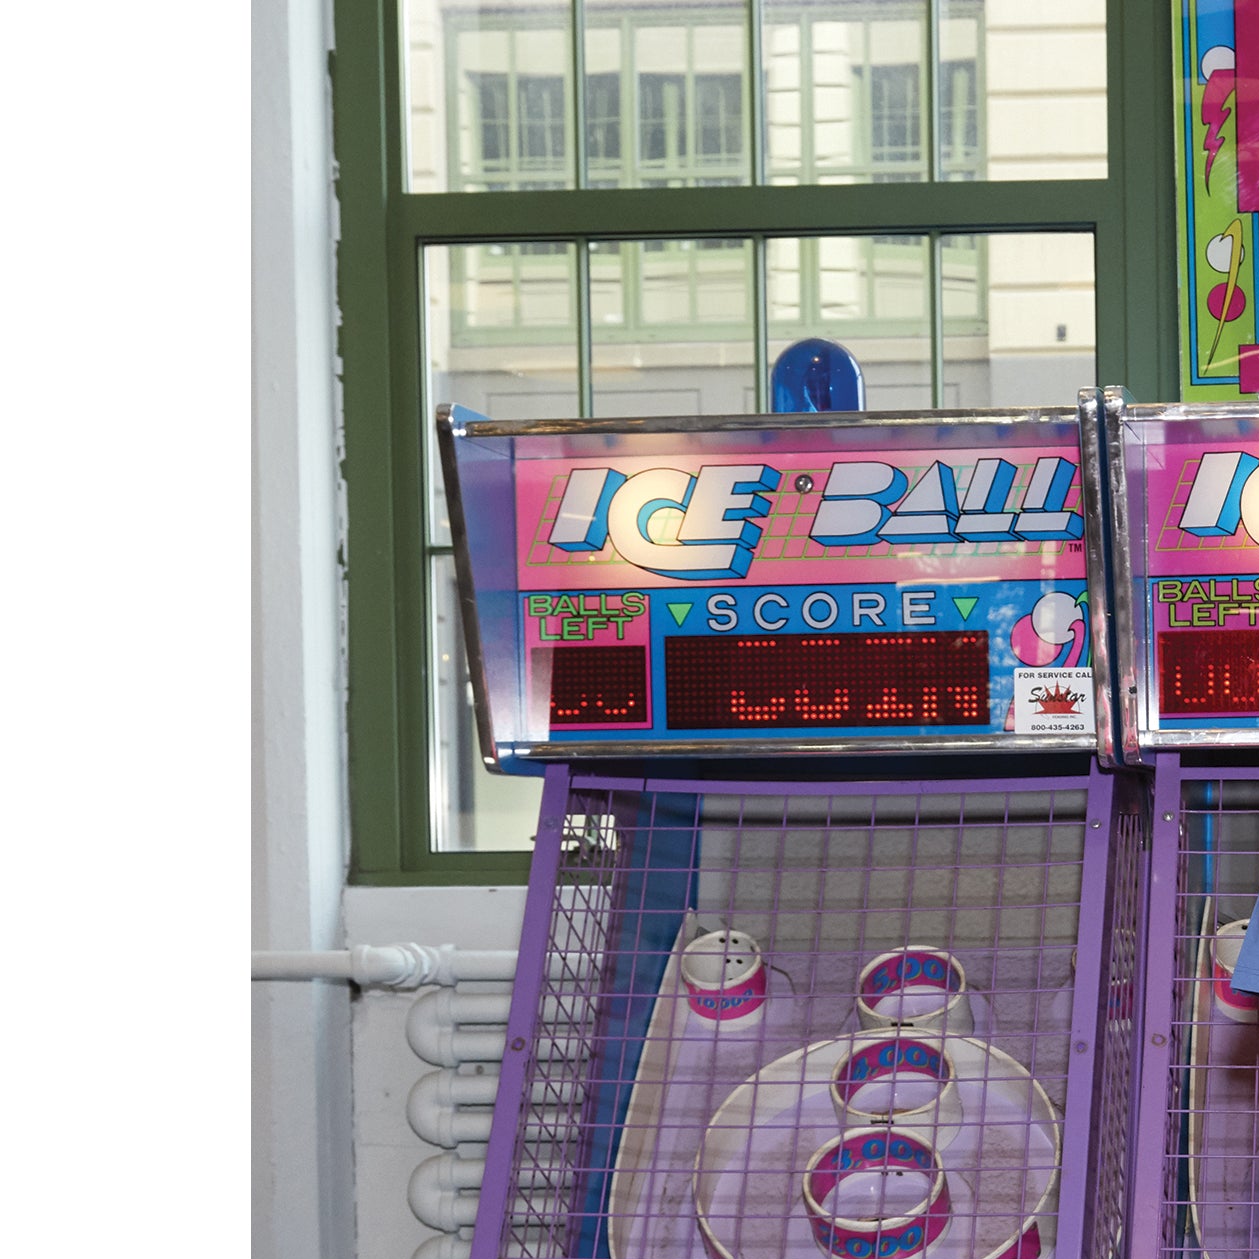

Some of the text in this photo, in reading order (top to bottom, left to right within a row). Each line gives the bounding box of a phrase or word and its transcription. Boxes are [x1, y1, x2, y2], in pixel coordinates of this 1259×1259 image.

[548, 464, 782, 580] ICE
[809, 457, 1084, 546] BALL
[528, 592, 645, 618] BALLS
[707, 591, 937, 632] SCORE
[539, 616, 632, 641] LEFT
[1037, 671, 1073, 679] SERVICE
[1075, 671, 1092, 679] CAL
